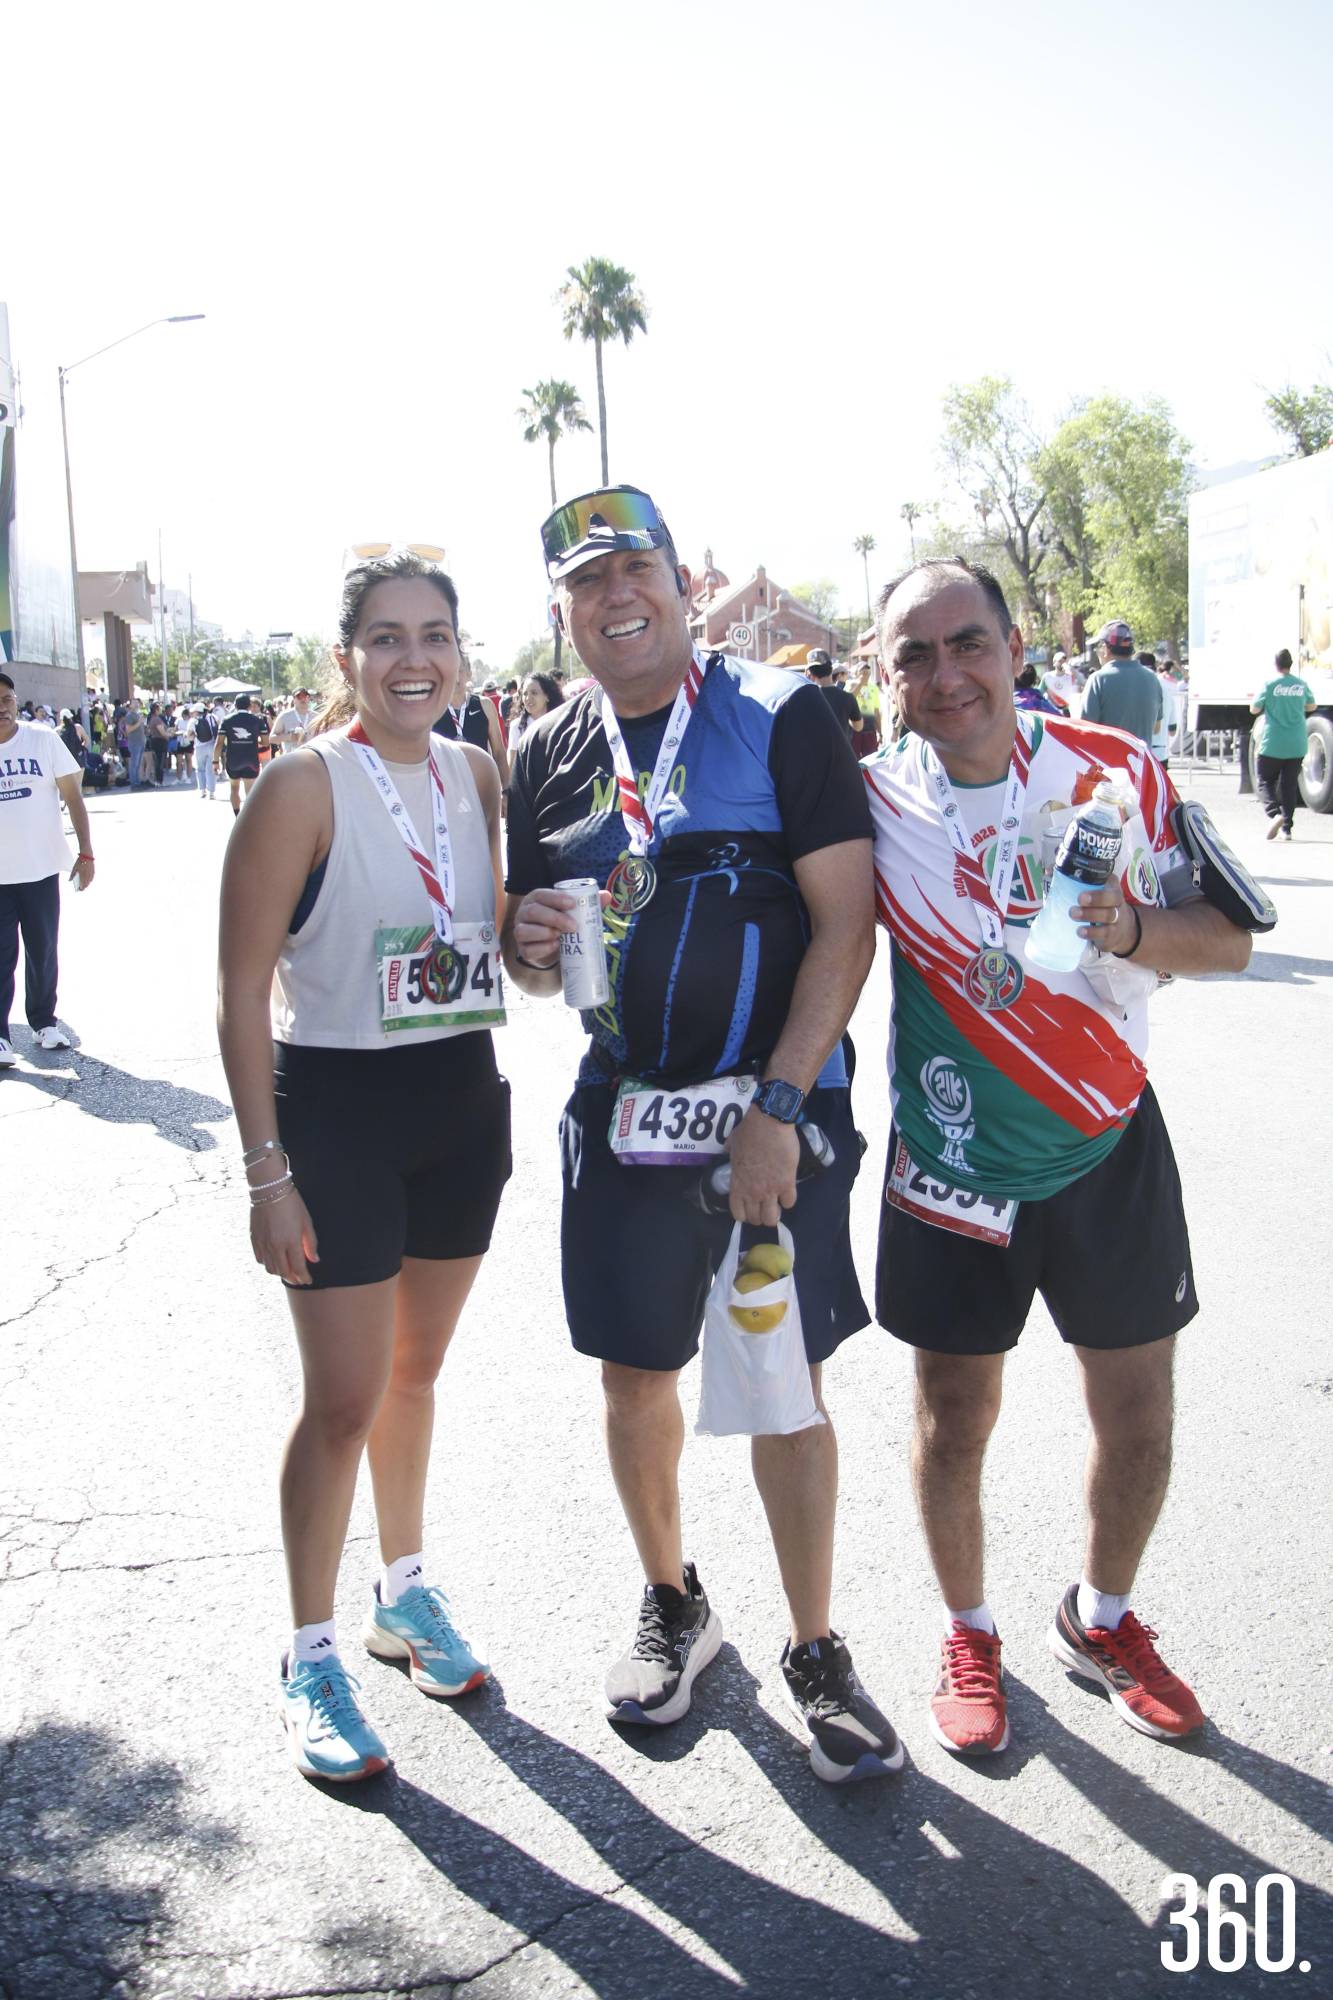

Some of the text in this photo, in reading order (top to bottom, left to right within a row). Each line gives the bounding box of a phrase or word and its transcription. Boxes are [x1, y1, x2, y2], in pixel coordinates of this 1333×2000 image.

[735, 629, 748, 640] 40
[590, 763, 687, 816] MRO
[1078, 827, 1122, 850] POWER
[559, 931, 583, 944] STEL
[560, 944, 583, 956] TRA
[389, 961, 400, 1000] SALTILLO
[619, 1099, 635, 1137] SALTILLO
[638, 1095, 744, 1145] 4380
[673, 1143, 696, 1151] MARIO
